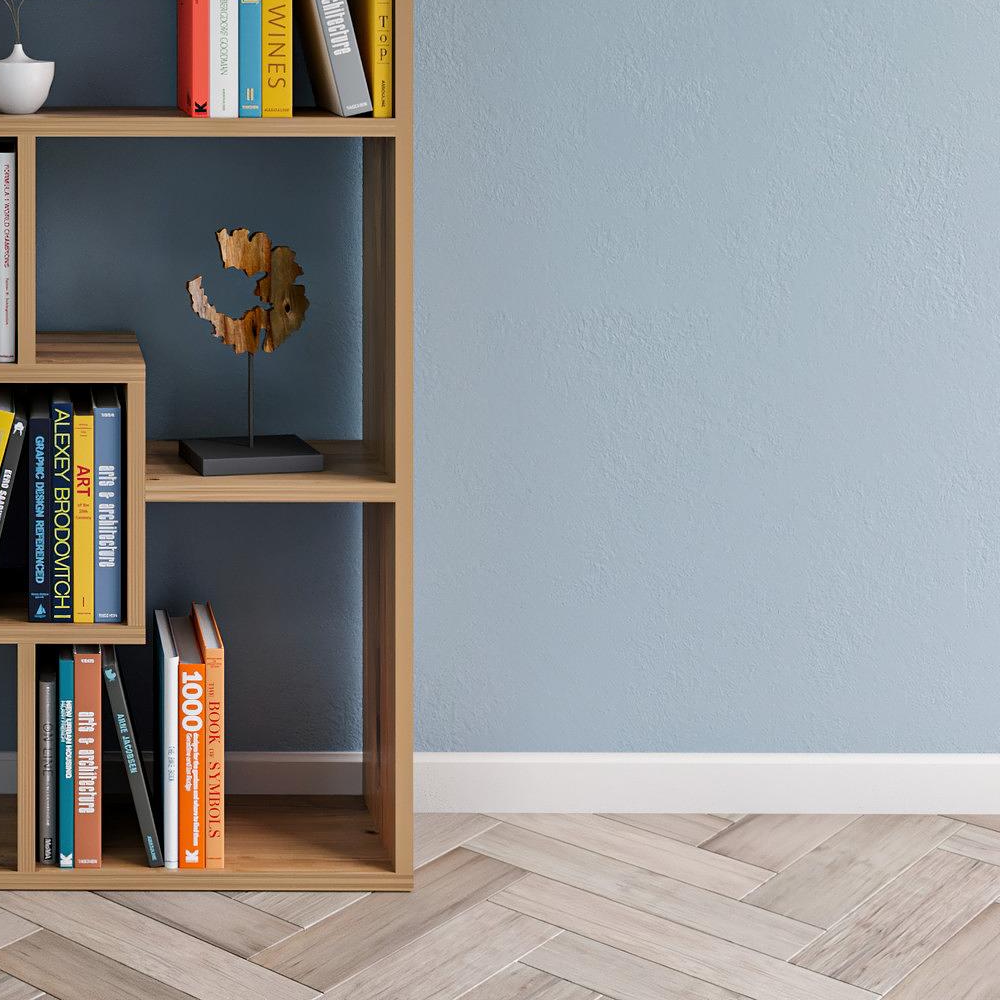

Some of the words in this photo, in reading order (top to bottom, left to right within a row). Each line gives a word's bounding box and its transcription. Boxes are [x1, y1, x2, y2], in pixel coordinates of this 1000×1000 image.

[220, 37, 228, 75] GOODMAN
[267, 5, 286, 89] WINES
[379, 16, 389, 61] Top
[34, 435, 44, 479] GRAPHIC
[54, 408, 70, 481] ALEXEY
[76, 465, 90, 497] ART
[98, 465, 116, 486] arts
[34, 481, 44, 516] DESIGN
[35, 519, 44, 584] REFERENCED
[54, 487, 70, 608] BRODOVITCH
[98, 503, 119, 567] architecture
[78, 711, 96, 731] arts
[182, 671, 203, 732] 1000
[208, 701, 221, 745] BOOK
[122, 735, 138, 774] JACOBSEN
[78, 749, 98, 813] architecture
[208, 761, 220, 838] SYMBOLS
[44, 838, 52, 859] MoMA
